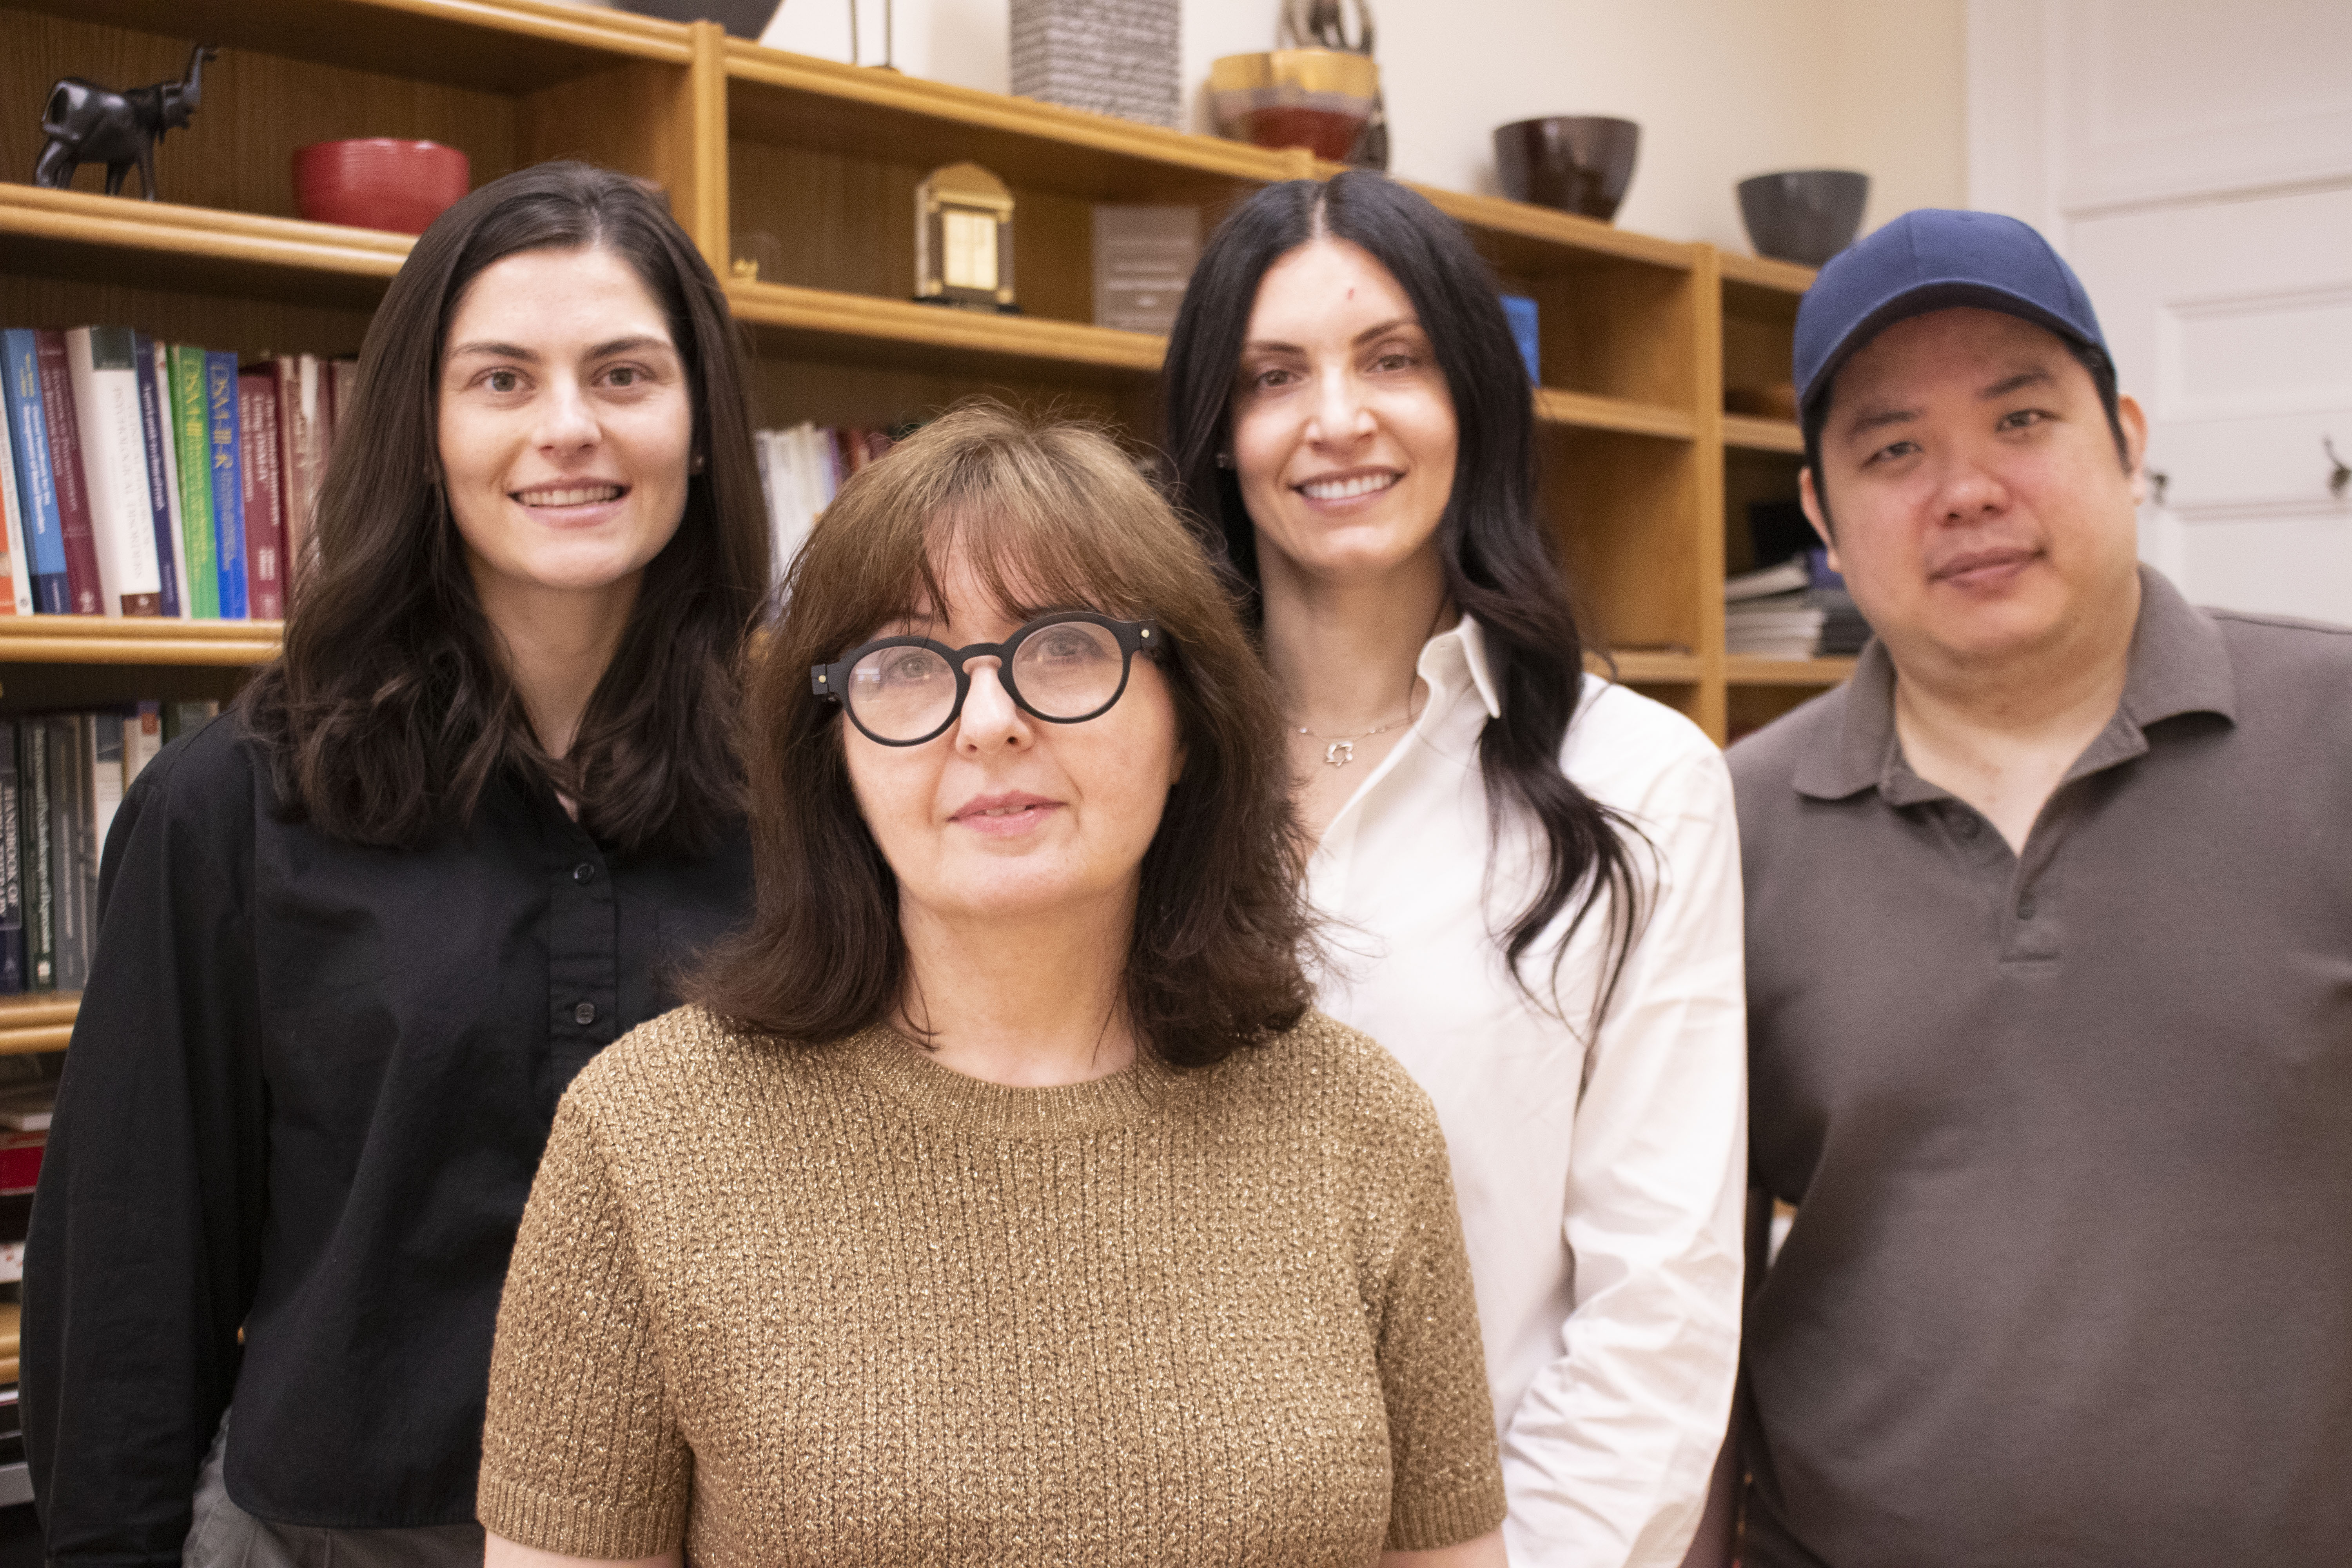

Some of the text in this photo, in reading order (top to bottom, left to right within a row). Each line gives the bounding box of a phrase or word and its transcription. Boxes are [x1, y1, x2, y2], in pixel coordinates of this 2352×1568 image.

[183, 359, 203, 437] DSM-III
[209, 364, 234, 469] DSM-III-R
[21, 404, 36, 460] Management
[33, 495, 46, 535] Disorders
[34, 436, 48, 477] Handbook
[111, 386, 136, 494] PSYCHOLOGICAL
[125, 502, 145, 579] DISORDERS
[267, 470, 281, 526] Interview
[3, 785, 18, 882] HANDBOOK
[6, 883, 19, 908] OF
